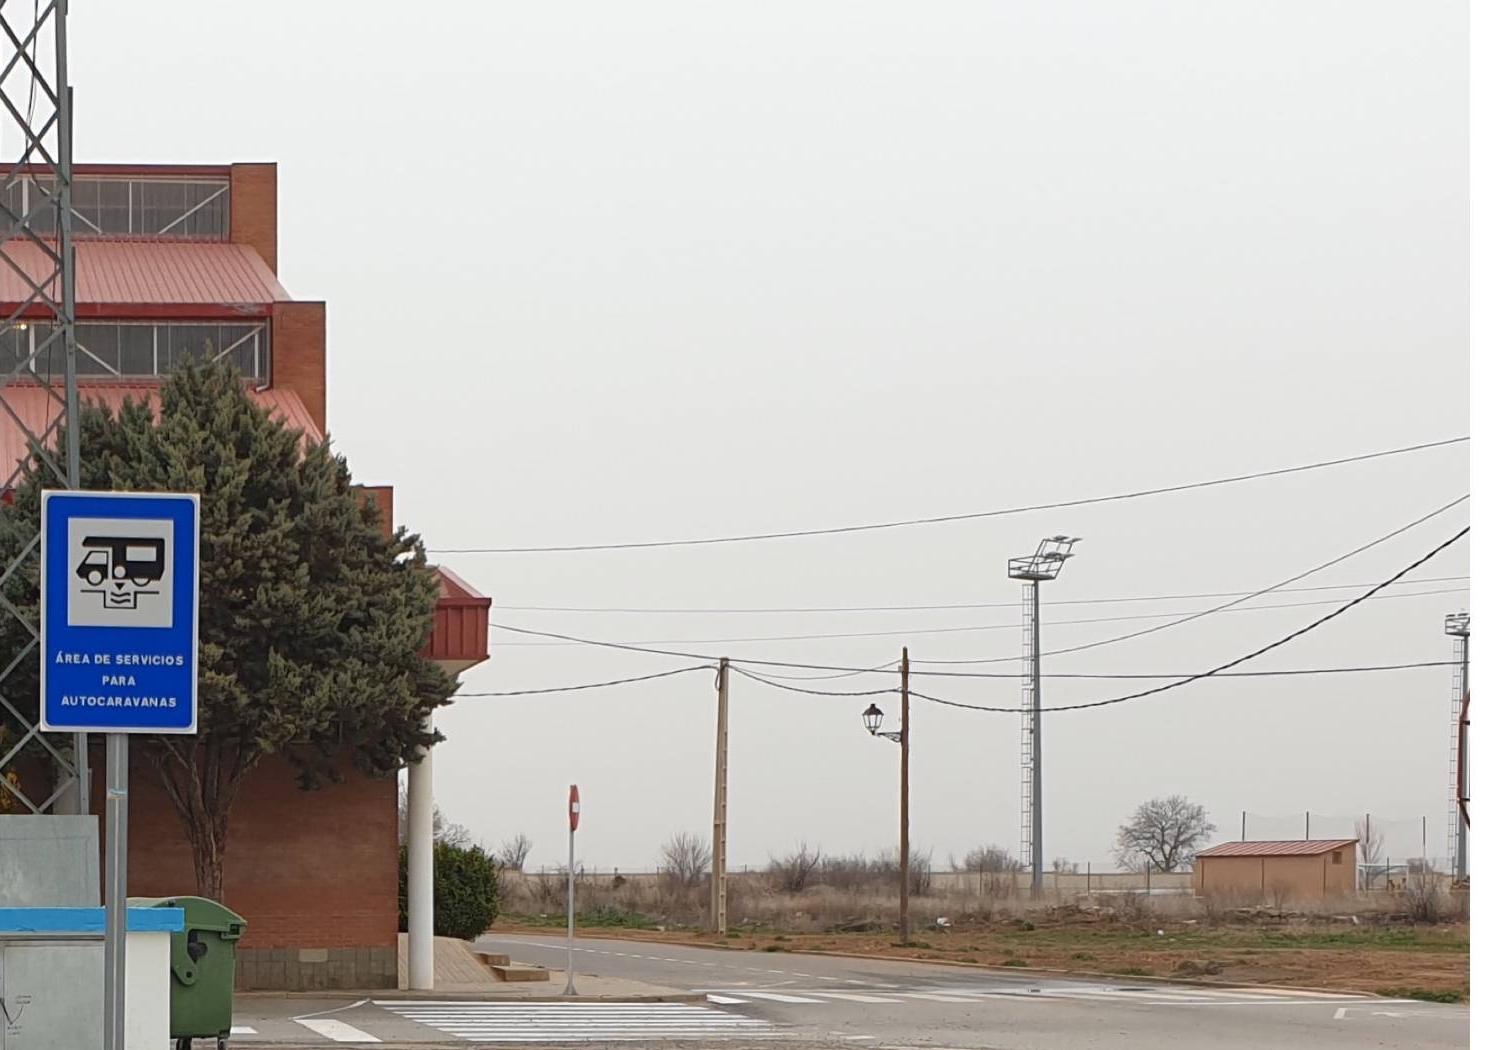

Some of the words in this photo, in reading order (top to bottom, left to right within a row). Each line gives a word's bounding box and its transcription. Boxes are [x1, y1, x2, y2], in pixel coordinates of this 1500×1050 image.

[55, 650, 90, 664] ÁREA
[94, 653, 111, 665] DE
[115, 654, 184, 666] SERVICIOS
[102, 675, 136, 686] PARA
[61, 695, 177, 708] AUTOCARAVANAS
